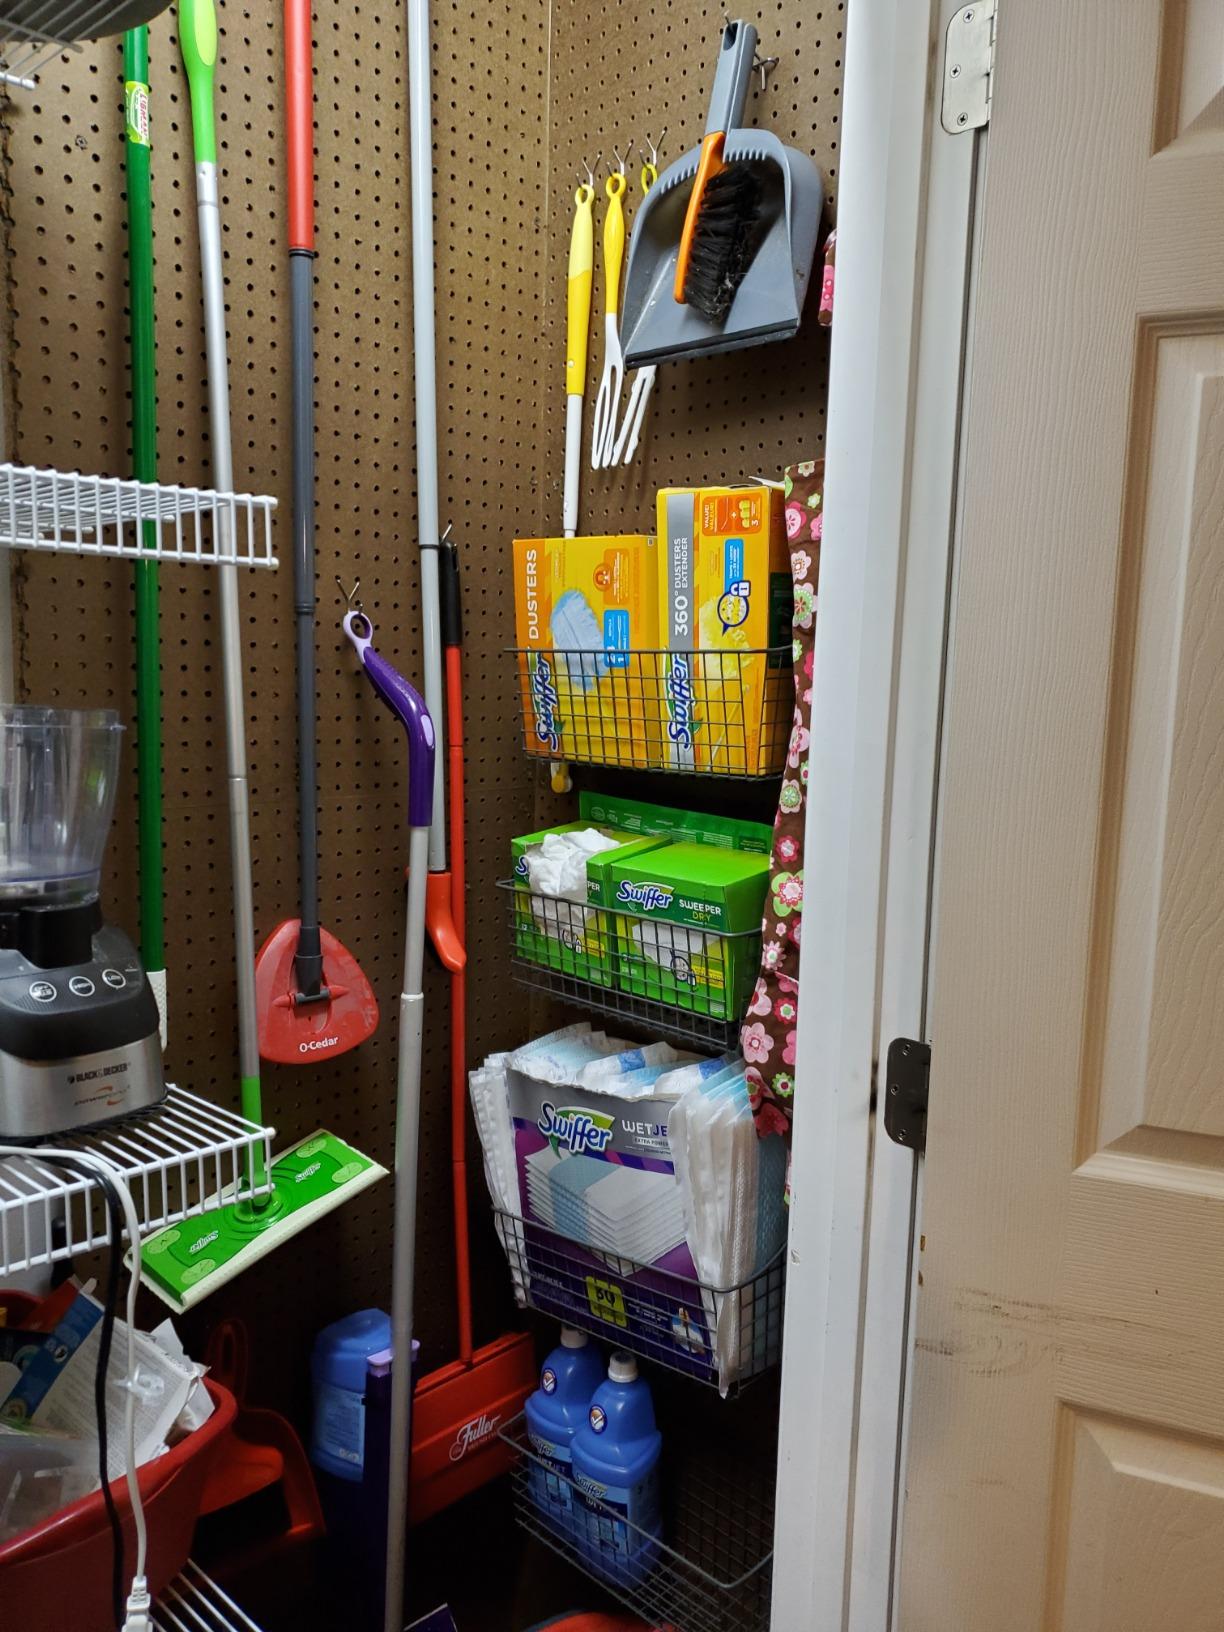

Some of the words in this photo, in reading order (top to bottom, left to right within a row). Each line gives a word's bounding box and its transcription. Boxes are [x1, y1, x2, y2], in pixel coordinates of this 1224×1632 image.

[673, 537, 682, 589] DUSTERS
[681, 536, 689, 589] EXTENDER
[525, 549, 539, 641] DUSTERS
[535, 654, 559, 751] Swiffer
[666, 652, 692, 750] Swiffer
[617, 880, 673, 910] Swiffer
[679, 899, 722, 916] SWEEPER
[692, 911, 711, 922] DRY
[299, 1036, 339, 1052] O-Cedar
[537, 1101, 613, 1153] Swiffer
[621, 1120, 669, 1141] WETJE
[295, 1163, 321, 1182] Swiffer
[449, 1414, 501, 1461] Fuller
[576, 1471, 607, 1498] Swiffer
